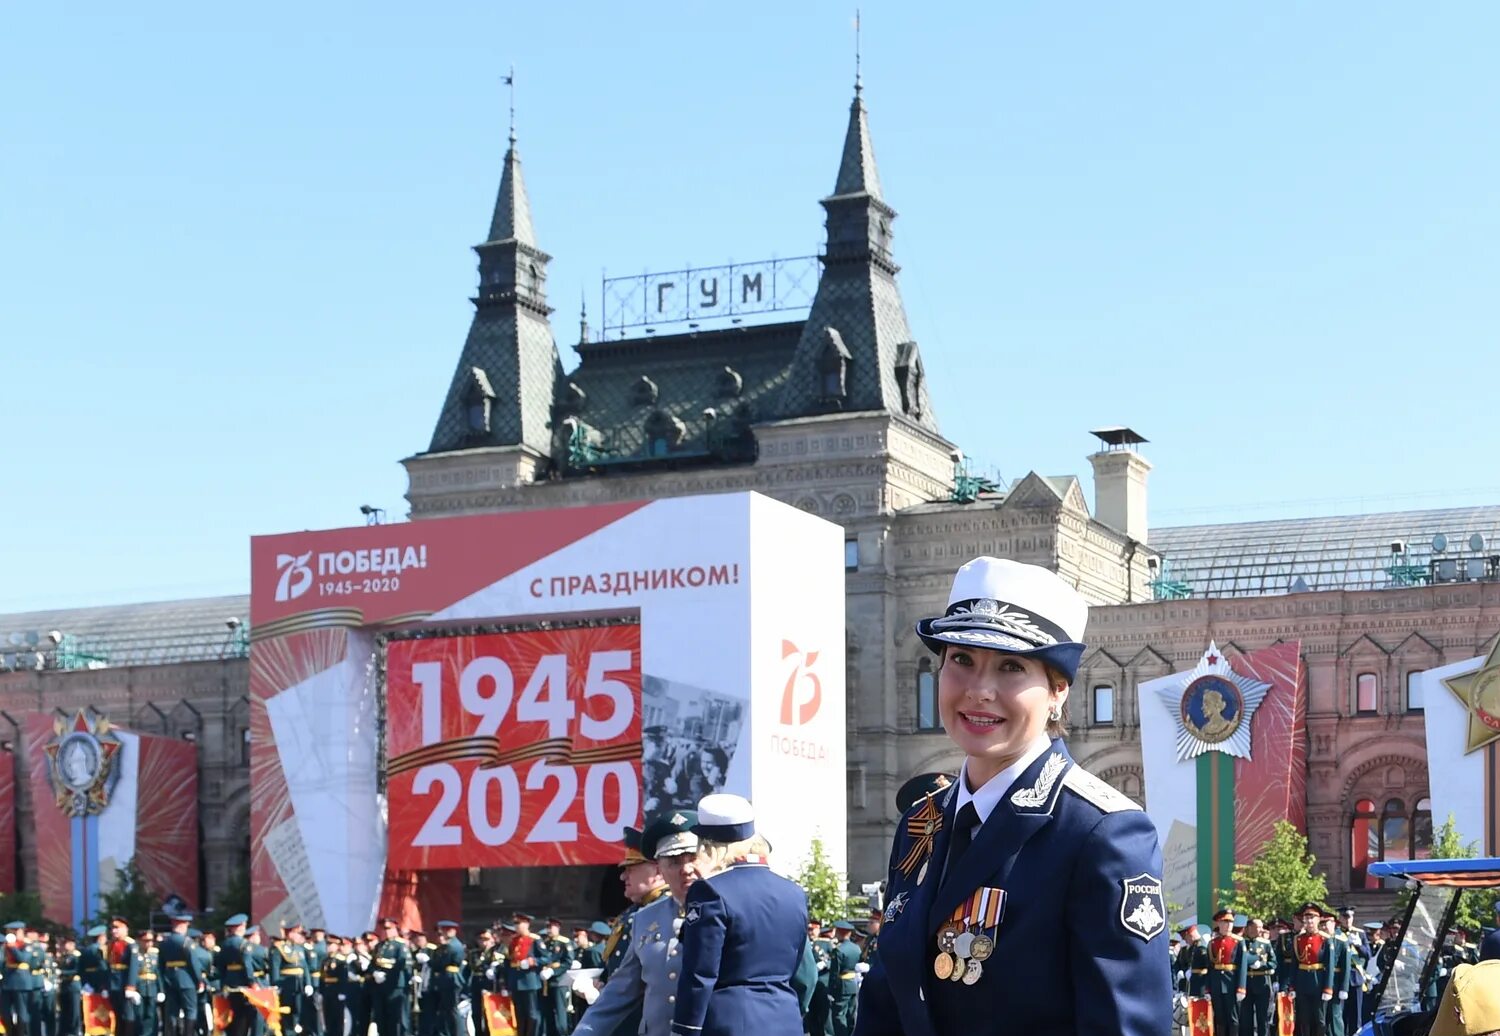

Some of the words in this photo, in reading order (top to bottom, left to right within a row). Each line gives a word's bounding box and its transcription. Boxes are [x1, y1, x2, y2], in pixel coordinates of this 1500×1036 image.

[657, 272, 762, 313] ГУМ
[318, 544, 427, 576] ПОБЕДА!
[530, 578, 543, 598] С
[551, 563, 739, 597] ПРАЗДНИКОМ!
[411, 650, 635, 747] 1945
[411, 758, 639, 847] 2020
[1129, 885, 1160, 895] РОССИЯ
